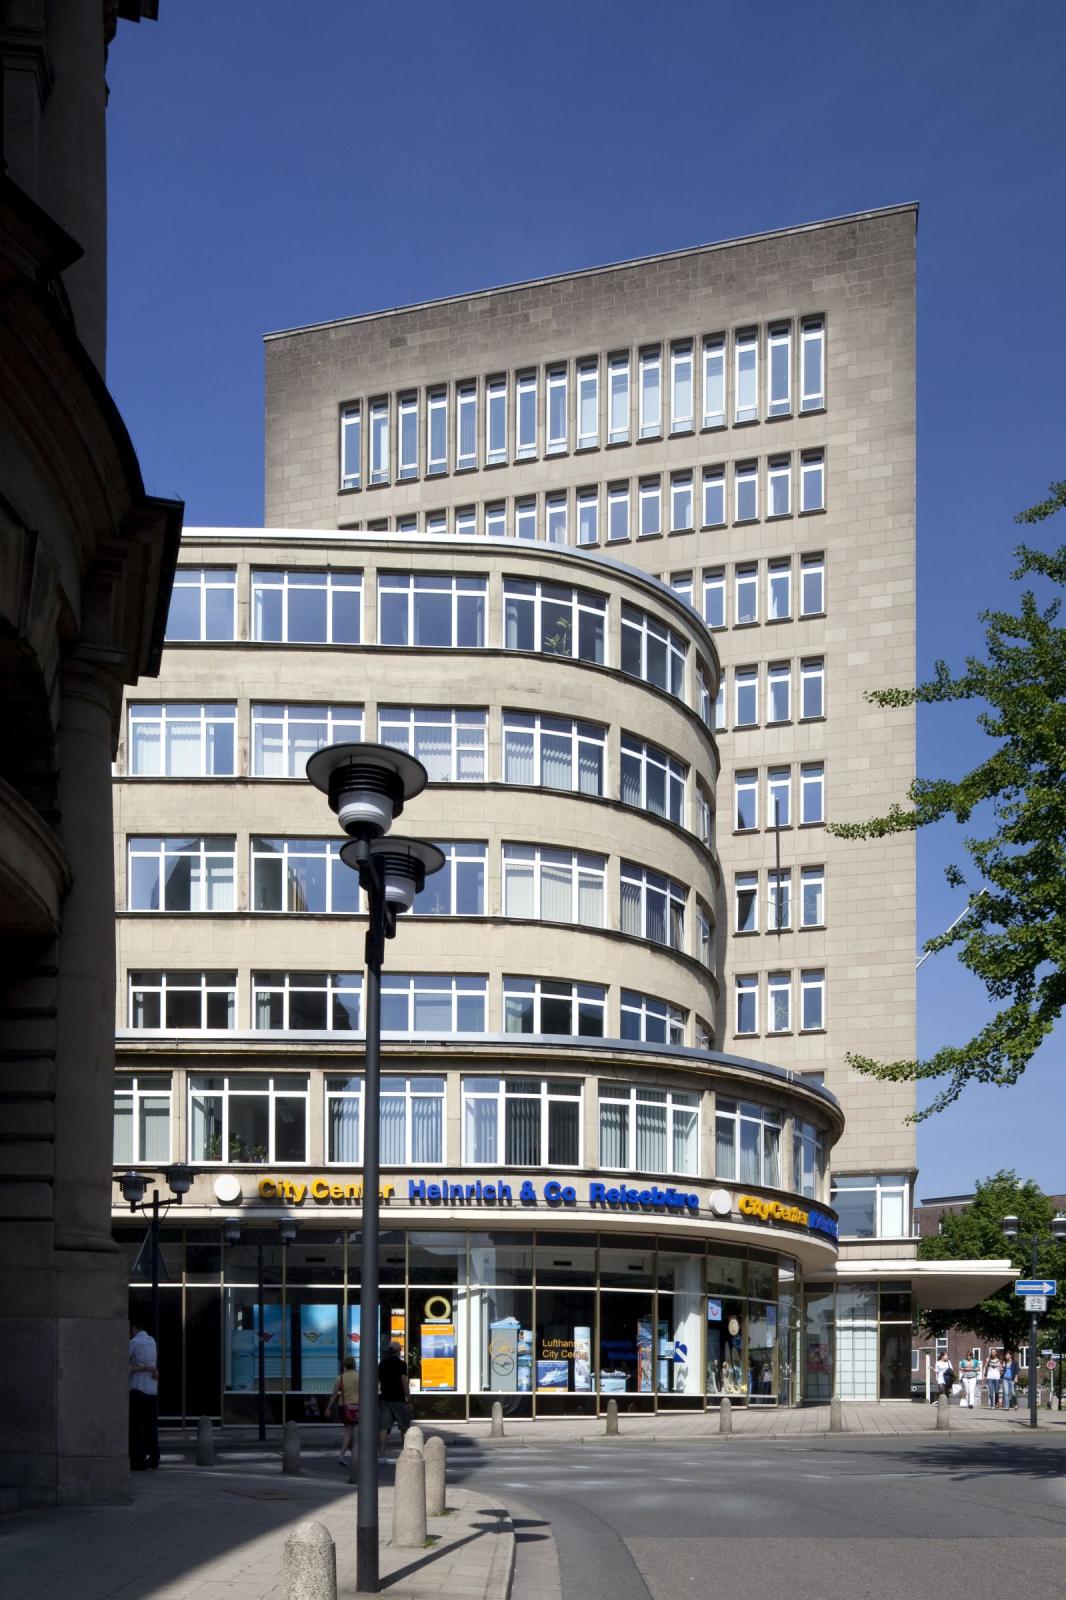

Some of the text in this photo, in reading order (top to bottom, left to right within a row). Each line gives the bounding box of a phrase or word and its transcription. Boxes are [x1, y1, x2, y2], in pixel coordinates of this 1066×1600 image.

[258, 1177, 699, 1208] City Cenr Heinrich & Co Reisebüro
[738, 1195, 769, 1220] City
[542, 1349, 559, 1359] City
